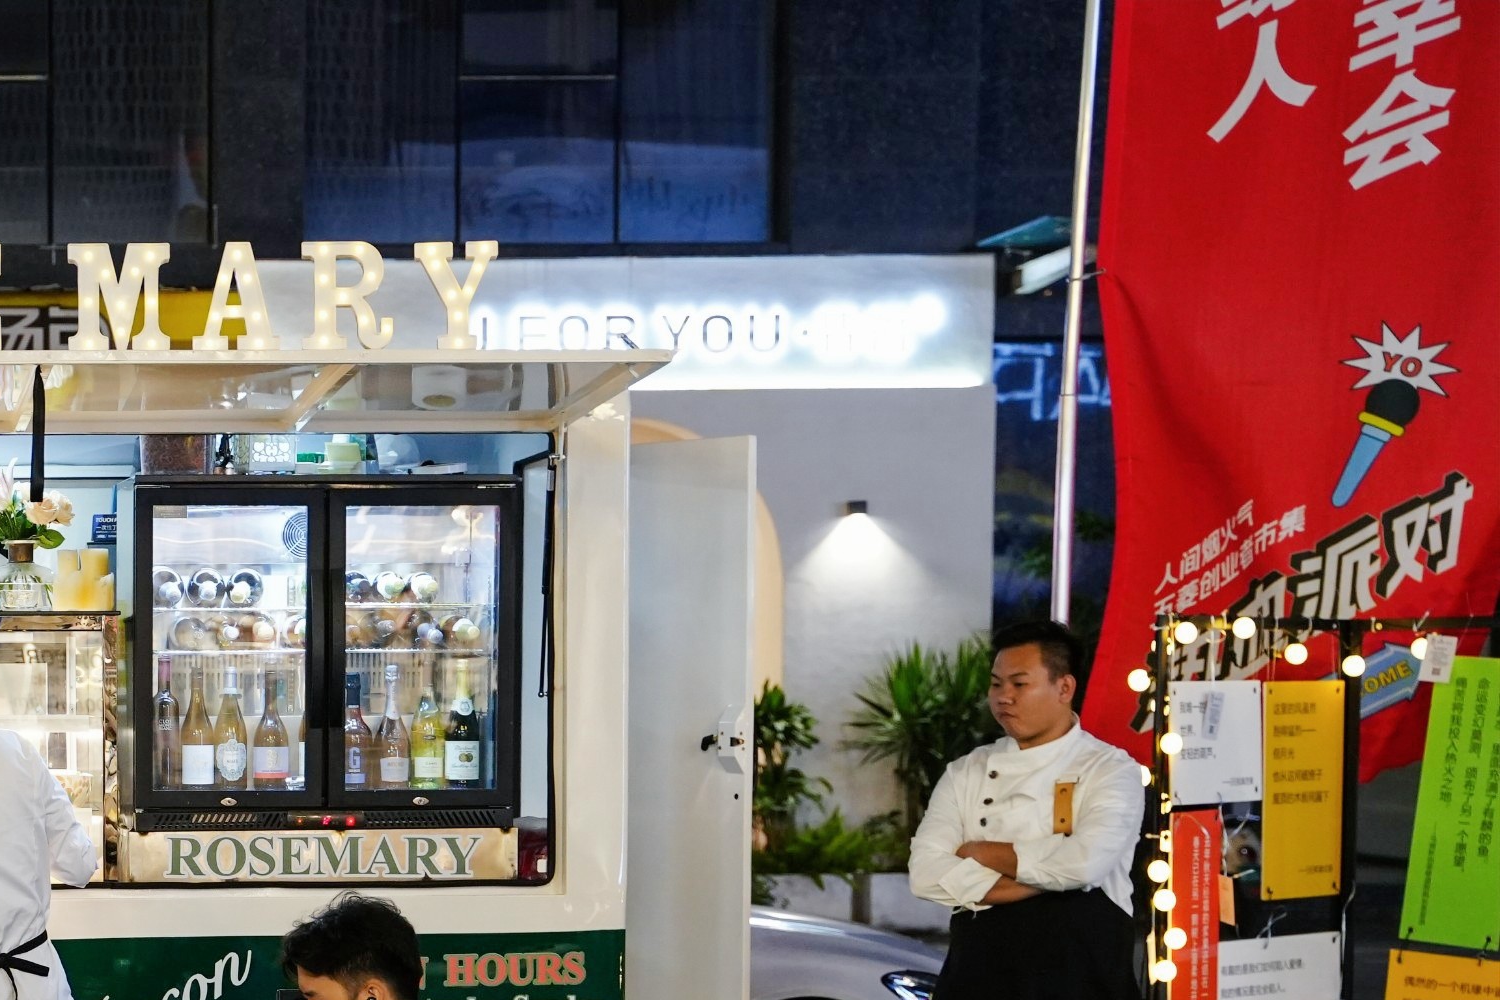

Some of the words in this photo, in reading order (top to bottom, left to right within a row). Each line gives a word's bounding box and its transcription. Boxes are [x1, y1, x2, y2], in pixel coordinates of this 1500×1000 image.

[67, 240, 500, 351] MARY
[518, 314, 637, 350] FOR
[661, 314, 781, 353] YOU
[1382, 351, 1423, 377] YO
[164, 835, 483, 878] ROSEMARY
[443, 951, 588, 988] HOURS
